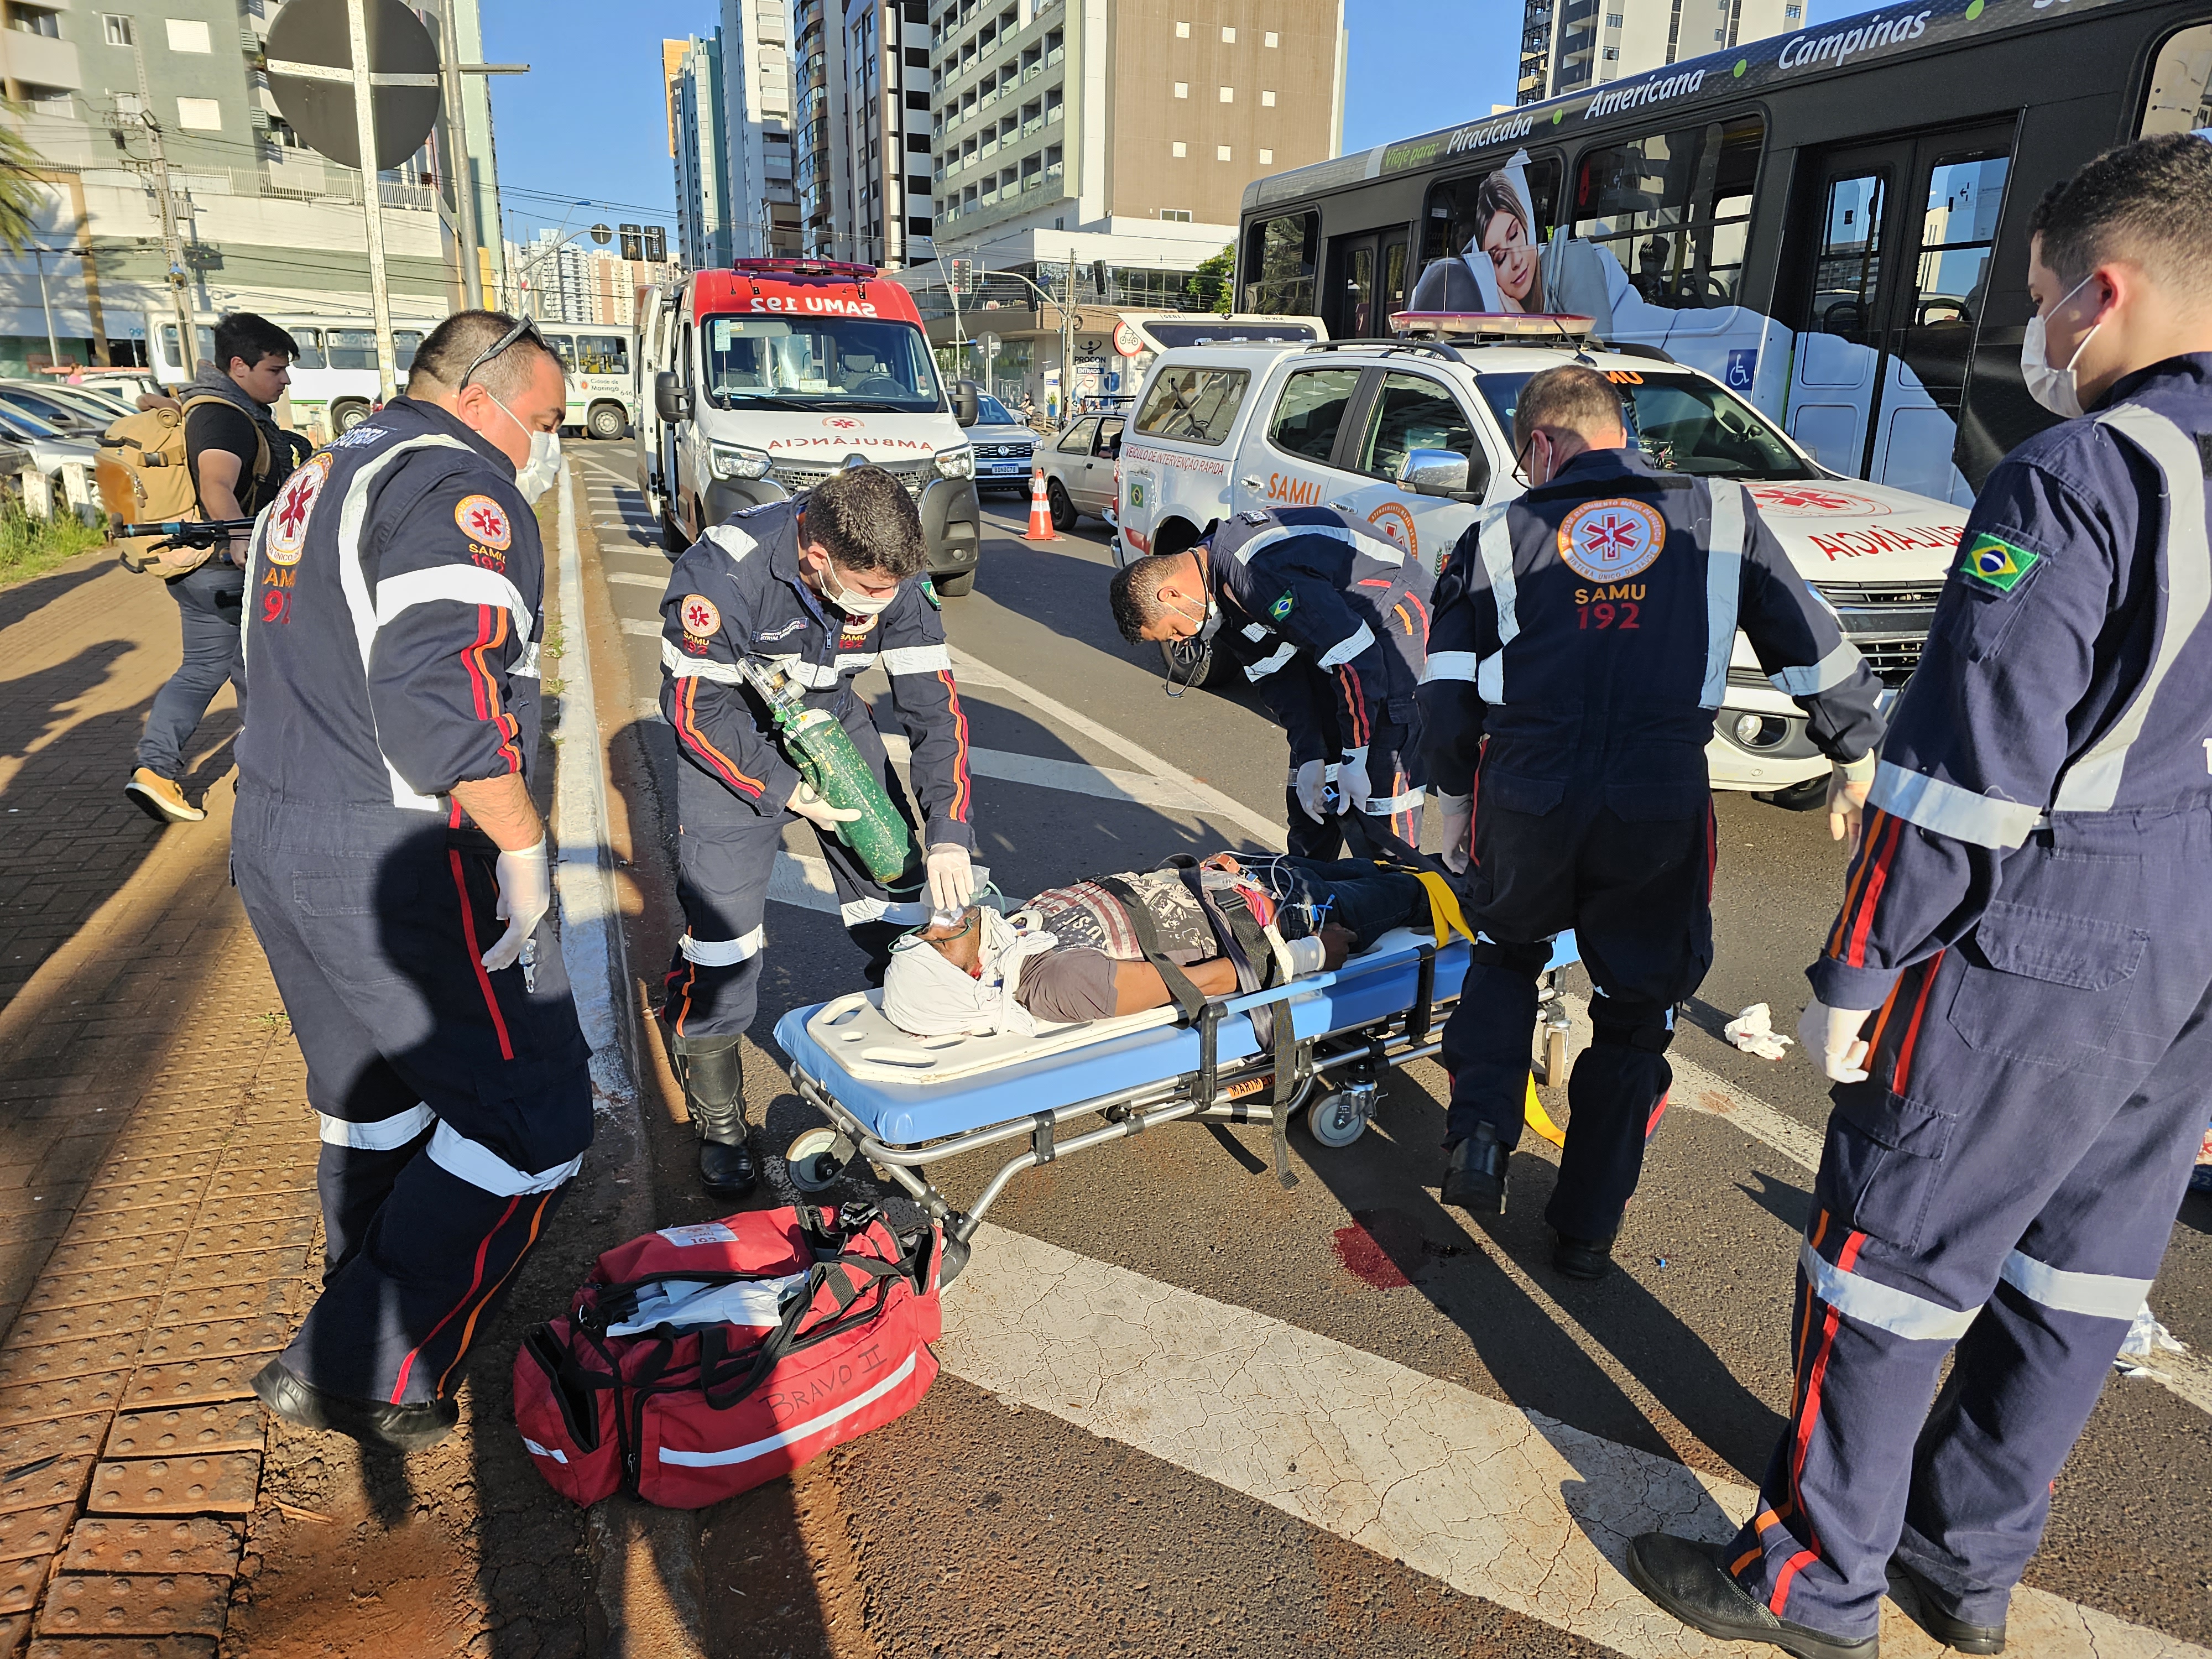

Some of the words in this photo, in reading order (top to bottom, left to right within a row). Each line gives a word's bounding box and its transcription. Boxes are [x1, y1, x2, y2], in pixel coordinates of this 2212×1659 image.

[1778, 9, 1932, 67] Campinas
[1584, 67, 1705, 121] Americana
[1447, 112, 1534, 155] Piracicaba
[1385, 147, 1410, 169] Viaje
[1410, 142, 1439, 166] para:
[1606, 371, 1644, 384] MU
[1147, 451, 1157, 462] DE
[1156, 452, 1199, 471] INTERVENÇÃO
[1267, 472, 1322, 505] SAMU
[1371, 505, 1401, 520] ATENDIMENTO
[1568, 515, 1576, 524] DE
[1575, 500, 1618, 518] ATENDIMENTO
[1620, 500, 1642, 511] MÓVEL
[1642, 508, 1652, 517] DE
[1648, 512, 1662, 542] URGÊNCIA
[468, 543, 506, 564] SAMU
[471, 554, 506, 574] 192
[1567, 555, 1594, 577] SISTEMA
[1598, 572, 1621, 580] ÚNICO
[1625, 566, 1635, 575] DE
[1636, 550, 1656, 569] SAÚDE
[1574, 584, 1646, 605] SAMU
[1577, 602, 1640, 630] 192
[682, 638, 708, 655] 192
[684, 630, 709, 646] SAMU
[838, 639, 864, 649] 192
[1230, 1074, 1274, 1097] MARIMED
[758, 1364, 852, 1430] BRAVO
[858, 1343, 888, 1374] II
